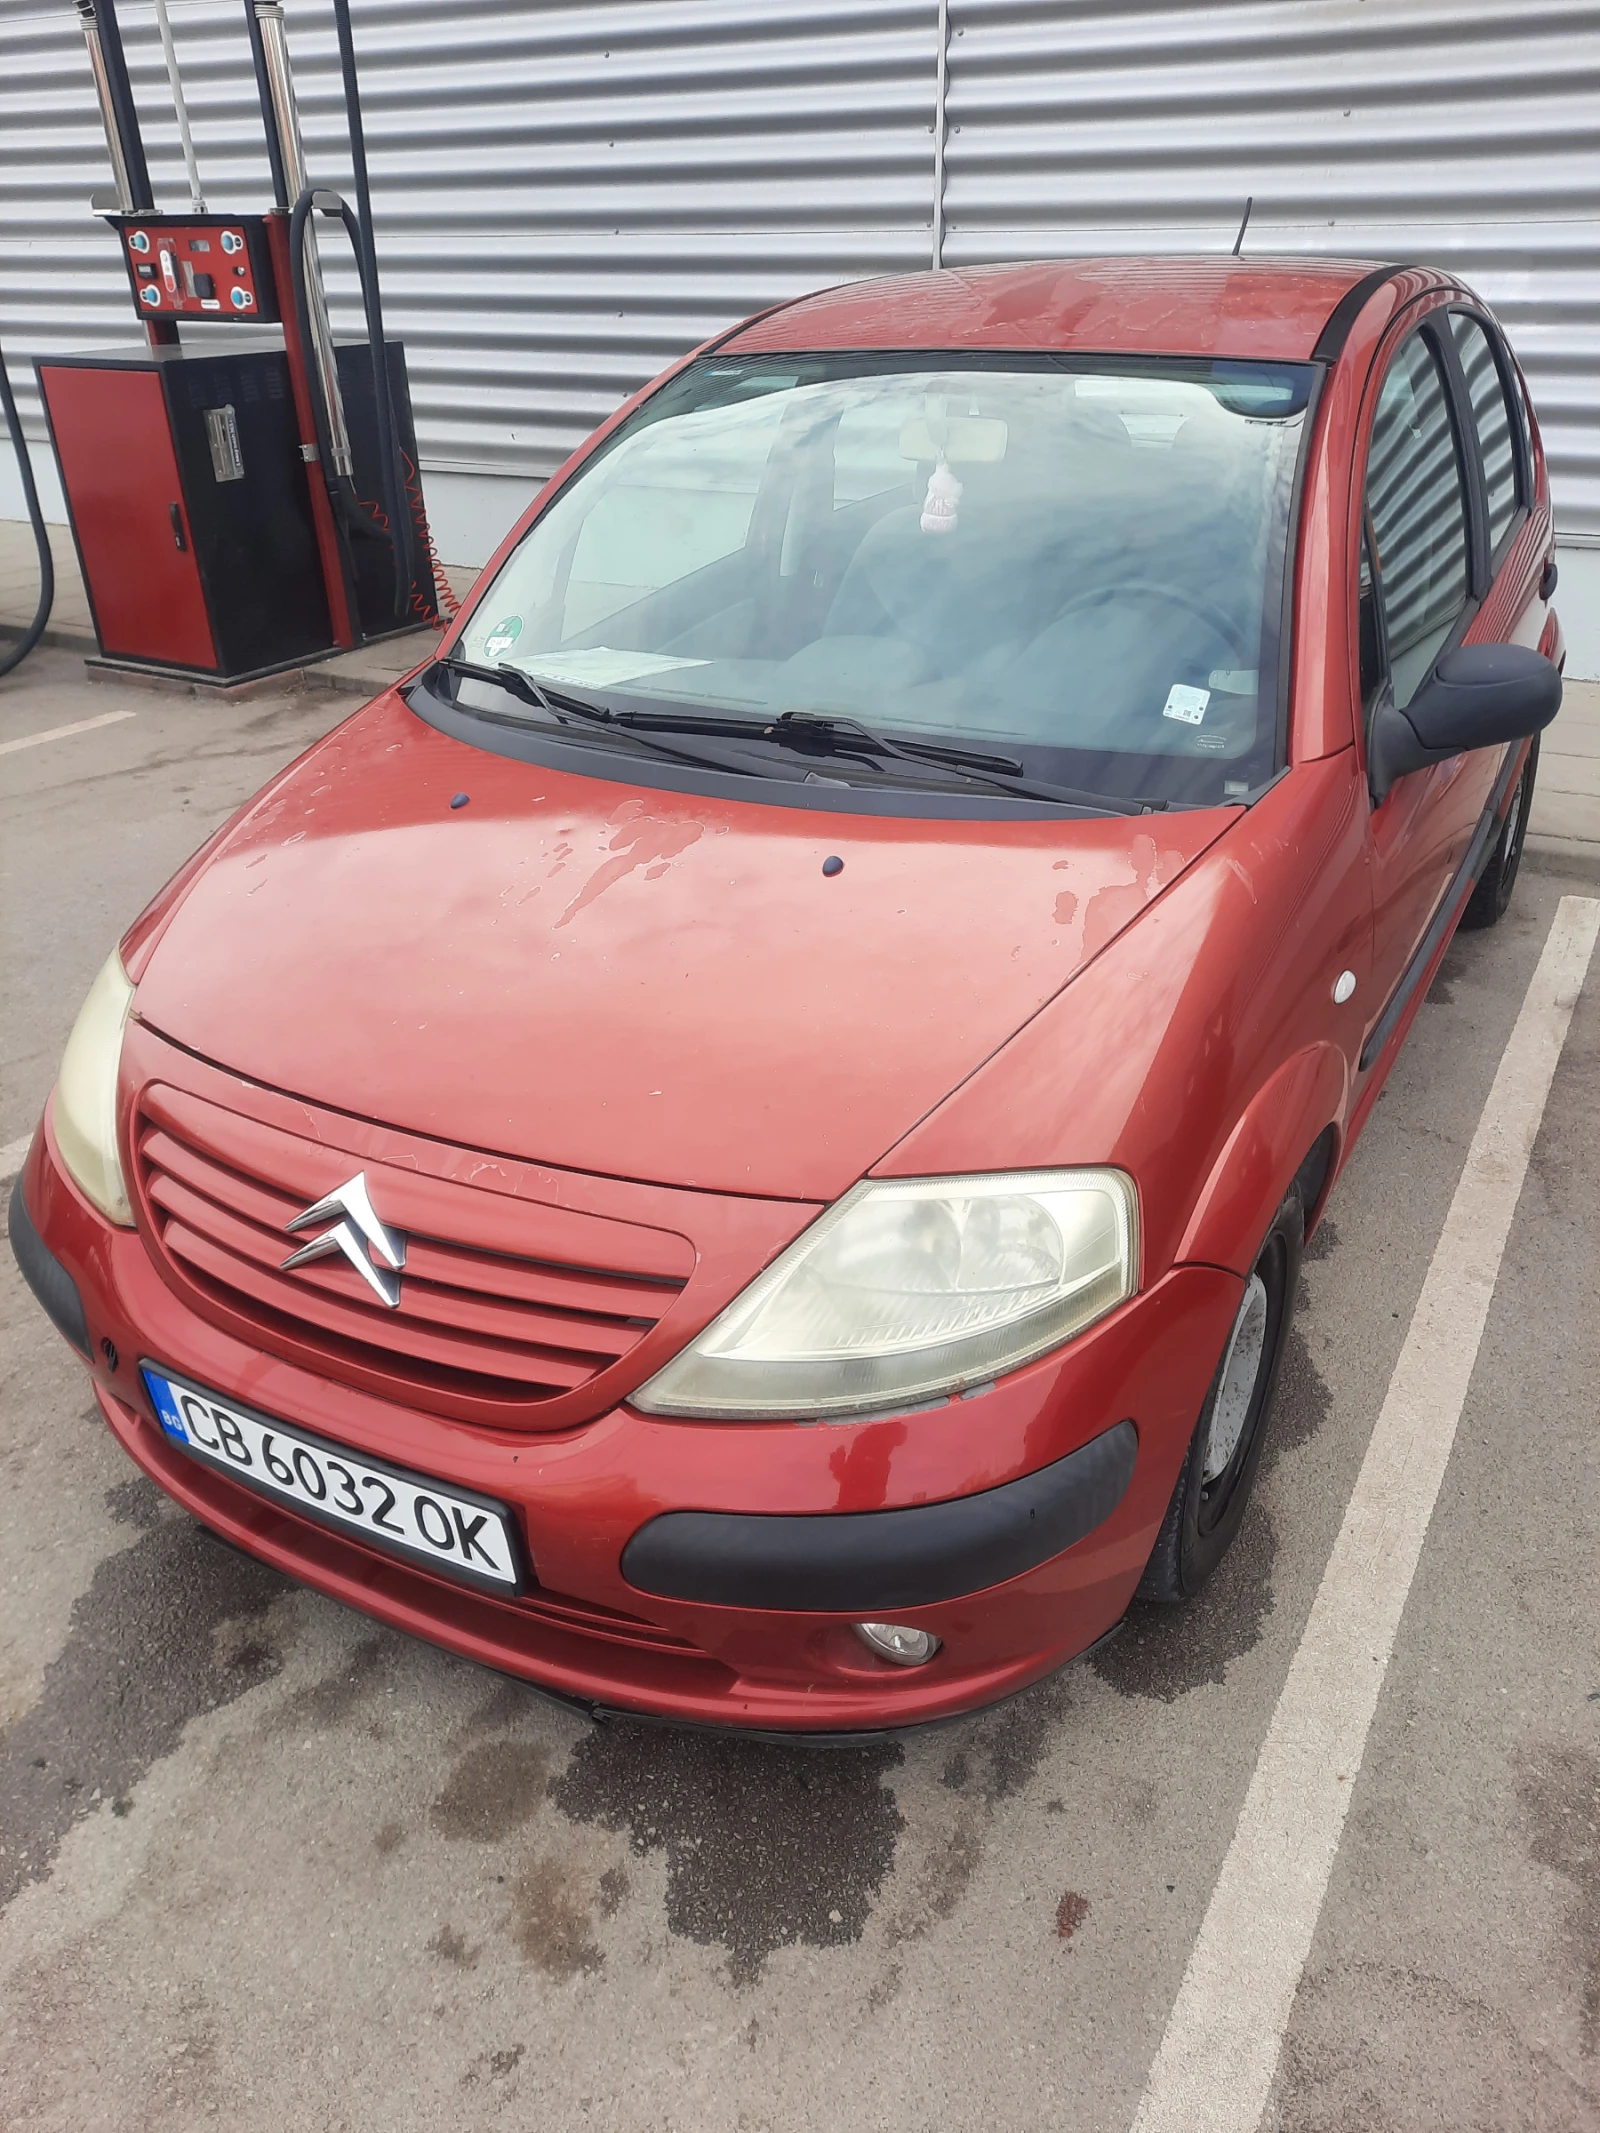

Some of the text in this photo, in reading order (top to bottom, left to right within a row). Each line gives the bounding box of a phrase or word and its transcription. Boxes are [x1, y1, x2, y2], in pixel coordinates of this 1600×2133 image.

[163, 1410, 183, 1431] BG
[180, 1396, 500, 1570] CB 6032 OK
